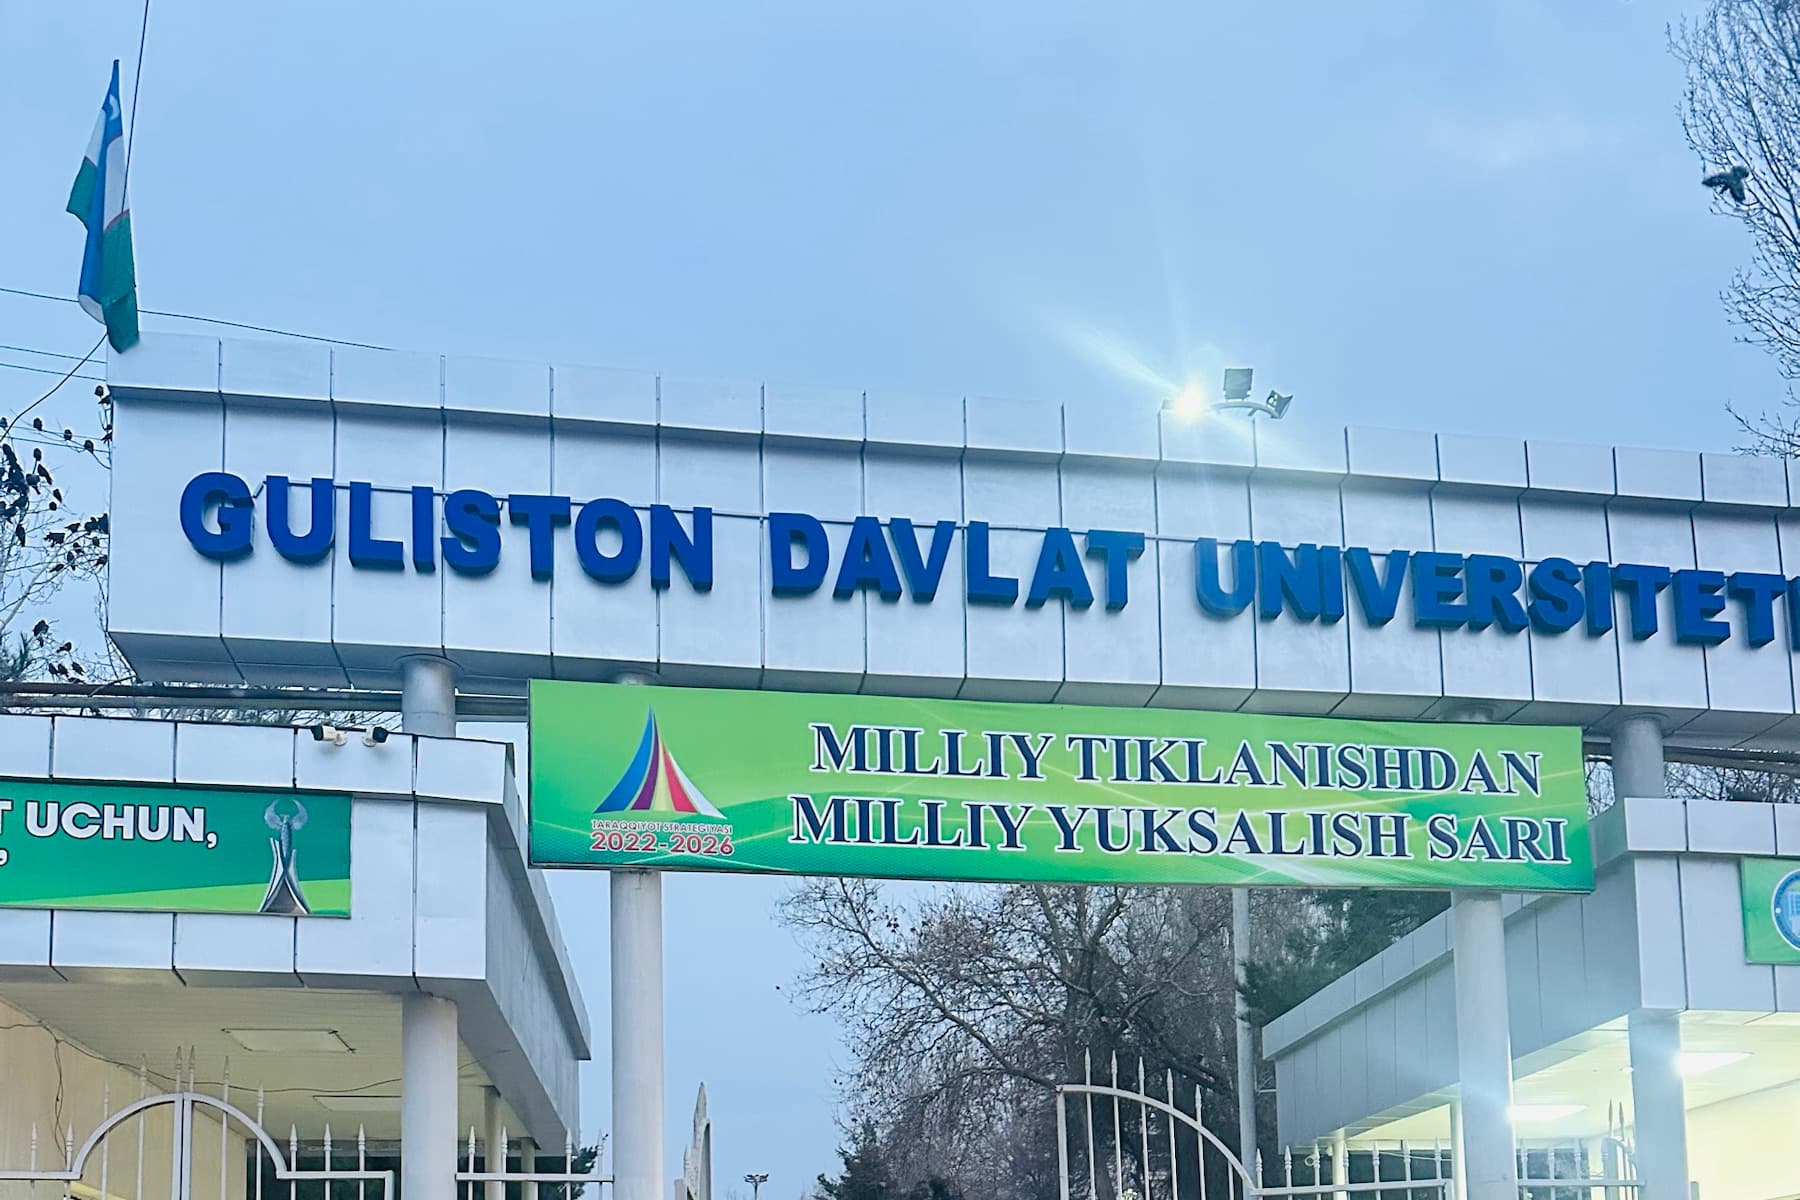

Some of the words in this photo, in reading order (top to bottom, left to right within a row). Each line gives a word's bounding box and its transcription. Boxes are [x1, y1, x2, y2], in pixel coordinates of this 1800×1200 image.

[180, 471, 713, 592] GULISTON
[769, 511, 1145, 612] DAVLAT
[809, 722, 1054, 780] MILLIY
[1066, 734, 1543, 798] TIKLANISHDAN
[25, 801, 218, 849] UCHUN,
[590, 831, 734, 856] 2022-2026
[591, 820, 661, 832] TARAQQIYOT
[663, 823, 733, 834] STRATEGIYASI
[788, 794, 1040, 851] MILLIY
[1045, 806, 1414, 859] YUKSALISH
[1426, 813, 1572, 865] SARI
